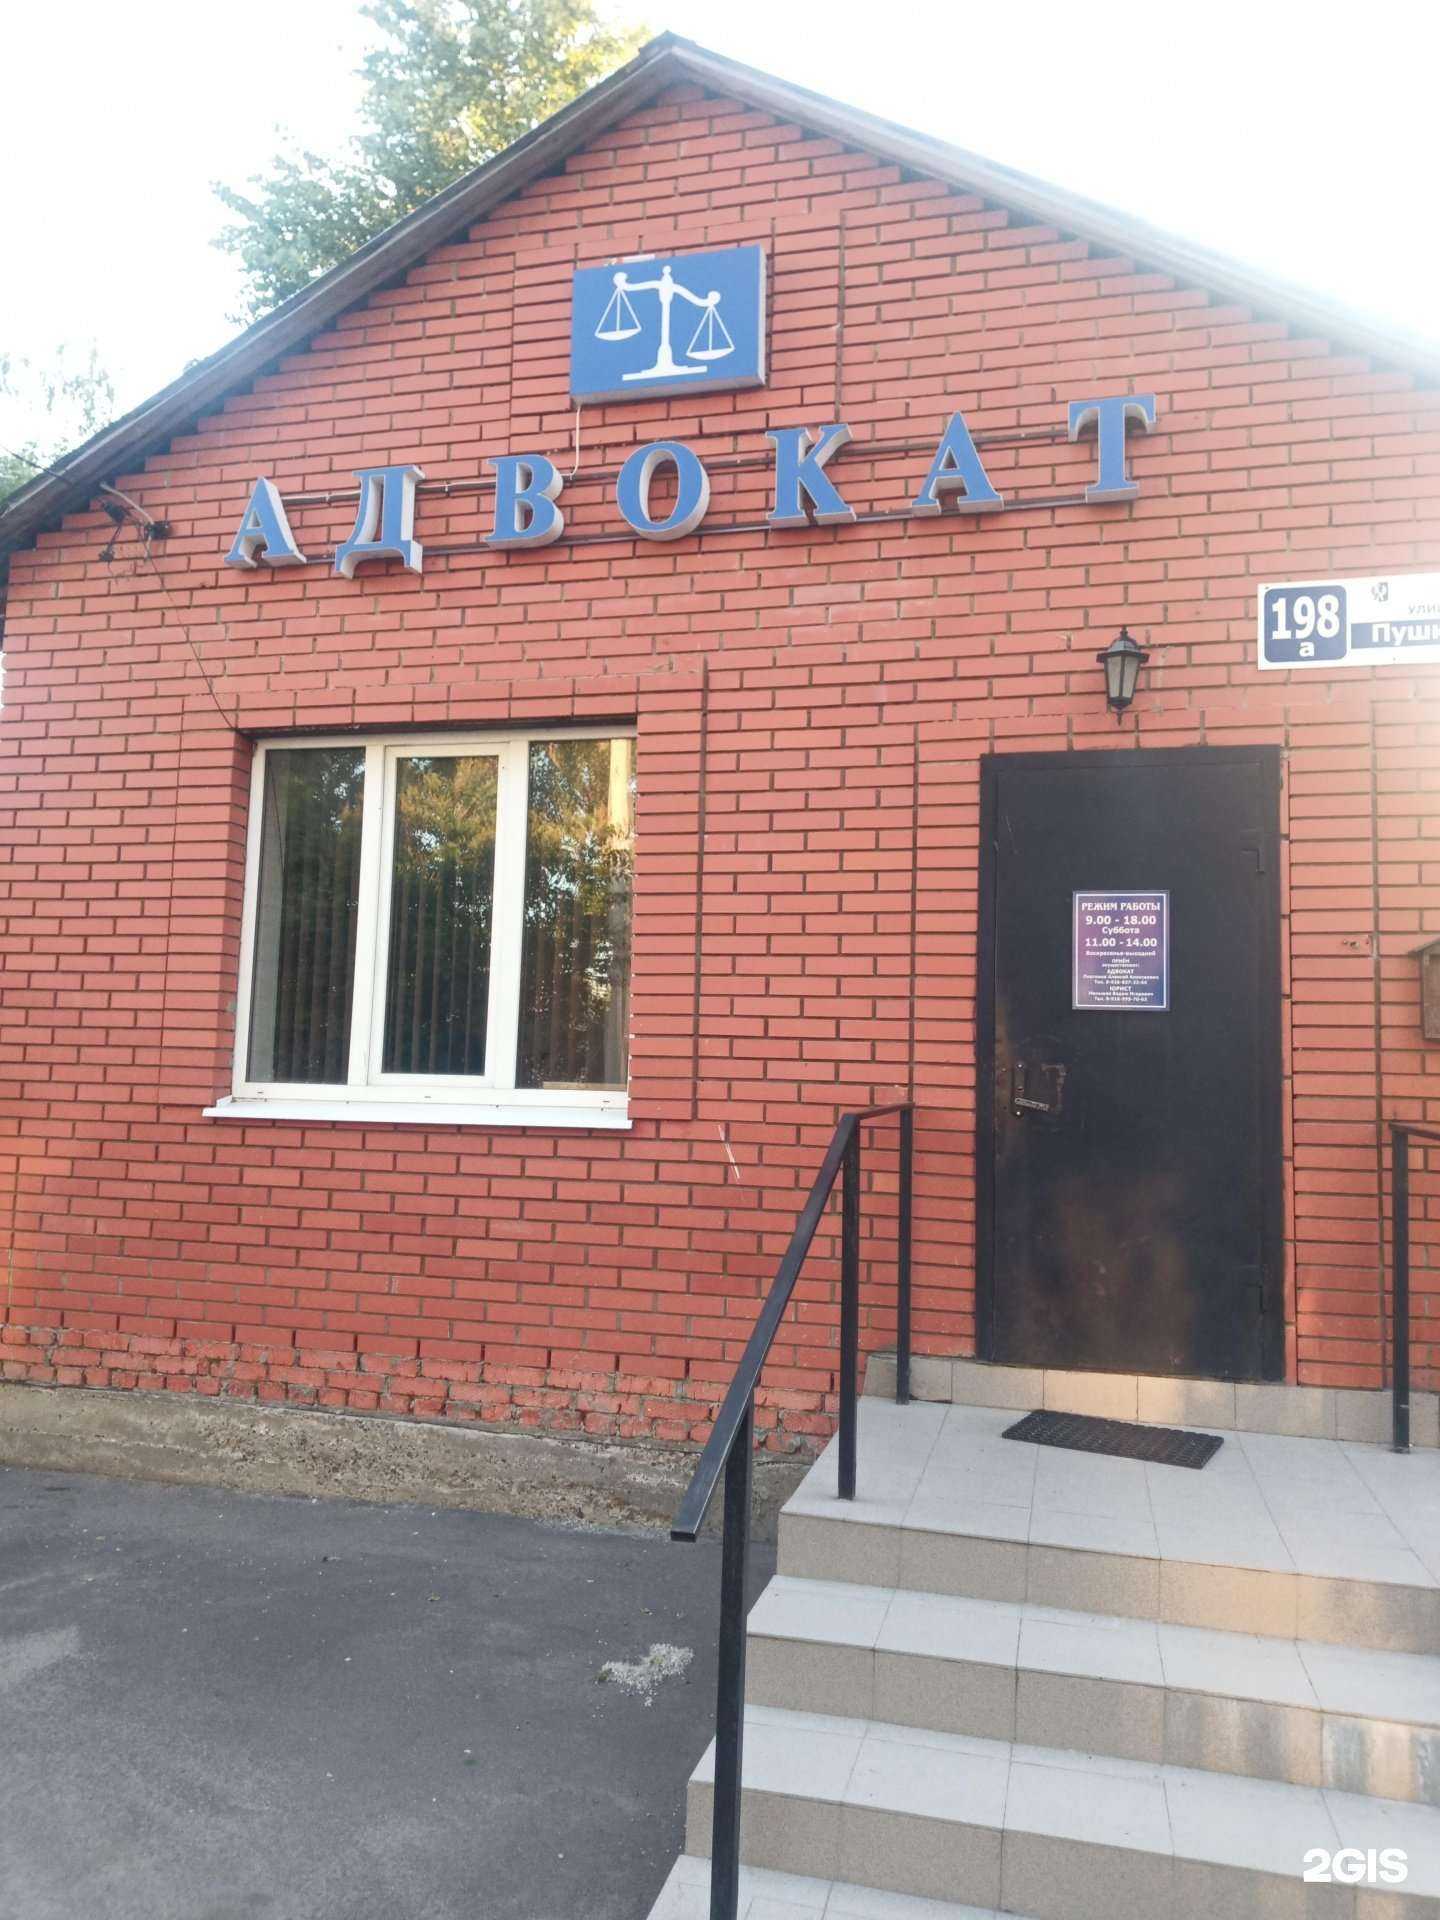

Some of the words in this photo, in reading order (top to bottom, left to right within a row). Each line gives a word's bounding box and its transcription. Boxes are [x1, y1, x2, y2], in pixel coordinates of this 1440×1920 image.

[224, 393, 1157, 579] АДВОКАТ
[1408, 602, 1440, 615] ули
[1271, 594, 1340, 640] 198
[1298, 641, 1315, 657] а
[1081, 902, 1118, 911] РЕЖИМ
[1120, 902, 1161, 911] РАБОТЫ
[1085, 915, 1112, 925] 9.00
[1123, 915, 1157, 925] 18.00
[1102, 926, 1140, 935] Суббота
[1085, 938, 1116, 947] 11.00
[1126, 938, 1158, 947] 14.00
